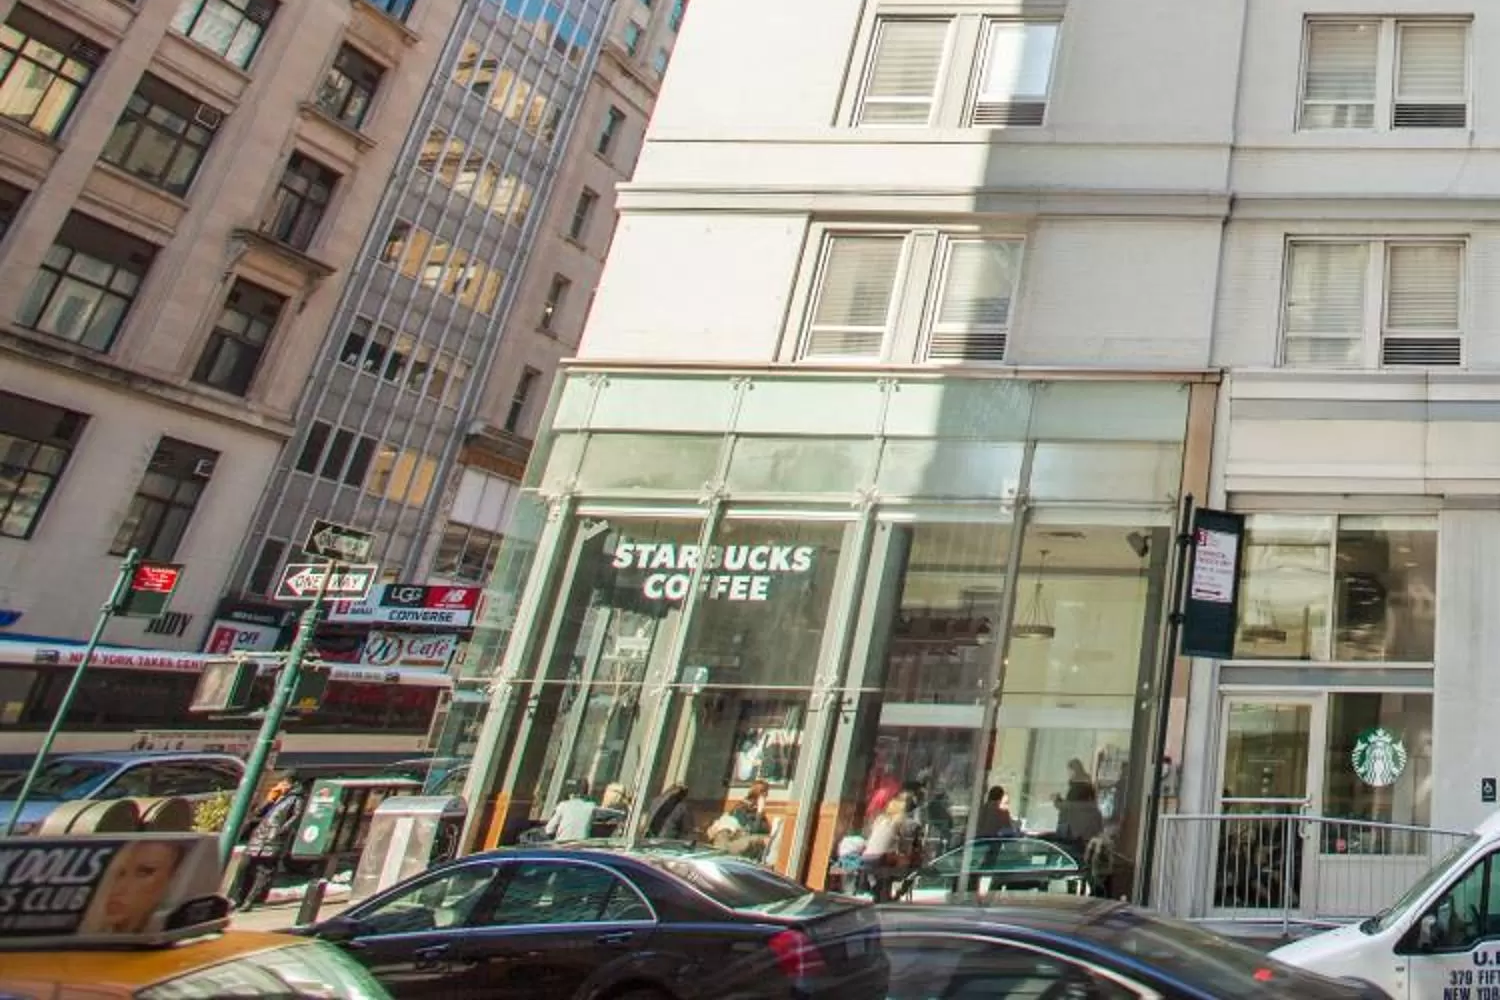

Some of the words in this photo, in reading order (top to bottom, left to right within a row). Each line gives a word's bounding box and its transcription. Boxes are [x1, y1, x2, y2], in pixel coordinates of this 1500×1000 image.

[612, 544, 813, 571] STARBUCKS
[294, 575, 323, 588] ONE
[391, 587, 423, 602] UGG
[388, 609, 456, 622] CONVERSE
[101, 653, 134, 666] YORK
[9, 848, 114, 884] DOLLS
[22, 887, 93, 911] CLUB
[1443, 987, 1471, 1000] NEW
